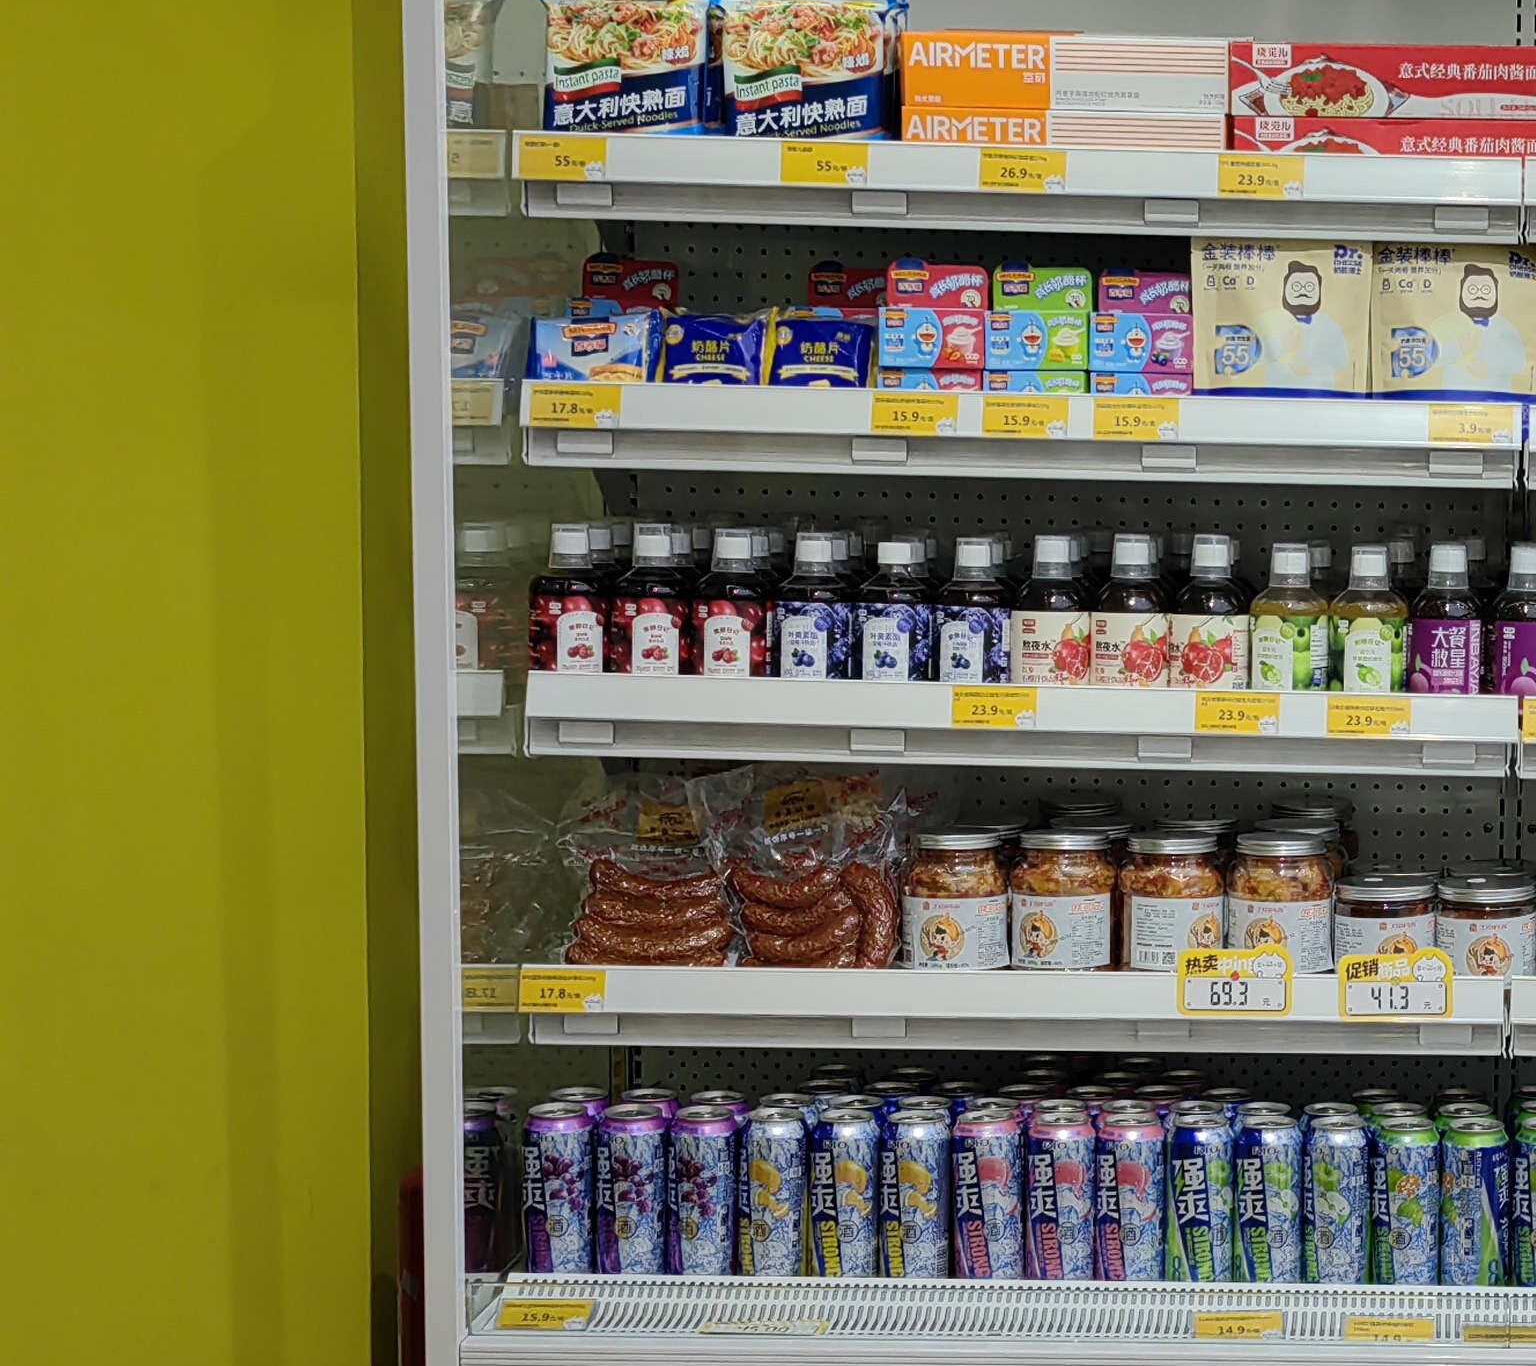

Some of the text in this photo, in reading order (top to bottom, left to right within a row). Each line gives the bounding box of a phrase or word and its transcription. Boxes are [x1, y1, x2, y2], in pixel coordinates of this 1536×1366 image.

[908, 41, 1045, 70] AIRMETER
[555, 67, 620, 89] Instant pasta
[736, 74, 800, 98] Instant pasta
[637, 110, 678, 125] Noodles
[820, 120, 861, 133] Noodles
[906, 114, 1042, 144] AIRMETER
[554, 155, 571, 167] 55
[816, 160, 832, 172] 55
[1000, 166, 1027, 179] 26.9
[1237, 174, 1265, 186] 23.9
[1333, 243, 1363, 260] Dr.
[695, 353, 725, 363] CHEESE
[803, 354, 834, 363] CHEESE
[1222, 344, 1249, 366] 55
[1398, 347, 1426, 369] 55
[550, 402, 578, 414] 17.8
[892, 410, 919, 422] 15.9
[1002, 415, 1030, 426] 15.9
[1114, 416, 1141, 427] 15.9
[1458, 422, 1477, 434] 3.9
[1431, 626, 1467, 649] 大餐
[1431, 649, 1467, 669] 救星
[971, 704, 998, 716] 23.9
[1218, 709, 1245, 721] 23.9
[1345, 715, 1373, 727] 23.9
[539, 987, 566, 1000] 17.8
[1209, 981, 1249, 1007] 69.3
[1370, 986, 1409, 1010] 41.3
[967, 1220, 992, 1278] STRONG
[1041, 1223, 1063, 1279] STRONG
[1104, 1223, 1126, 1280] STRONG
